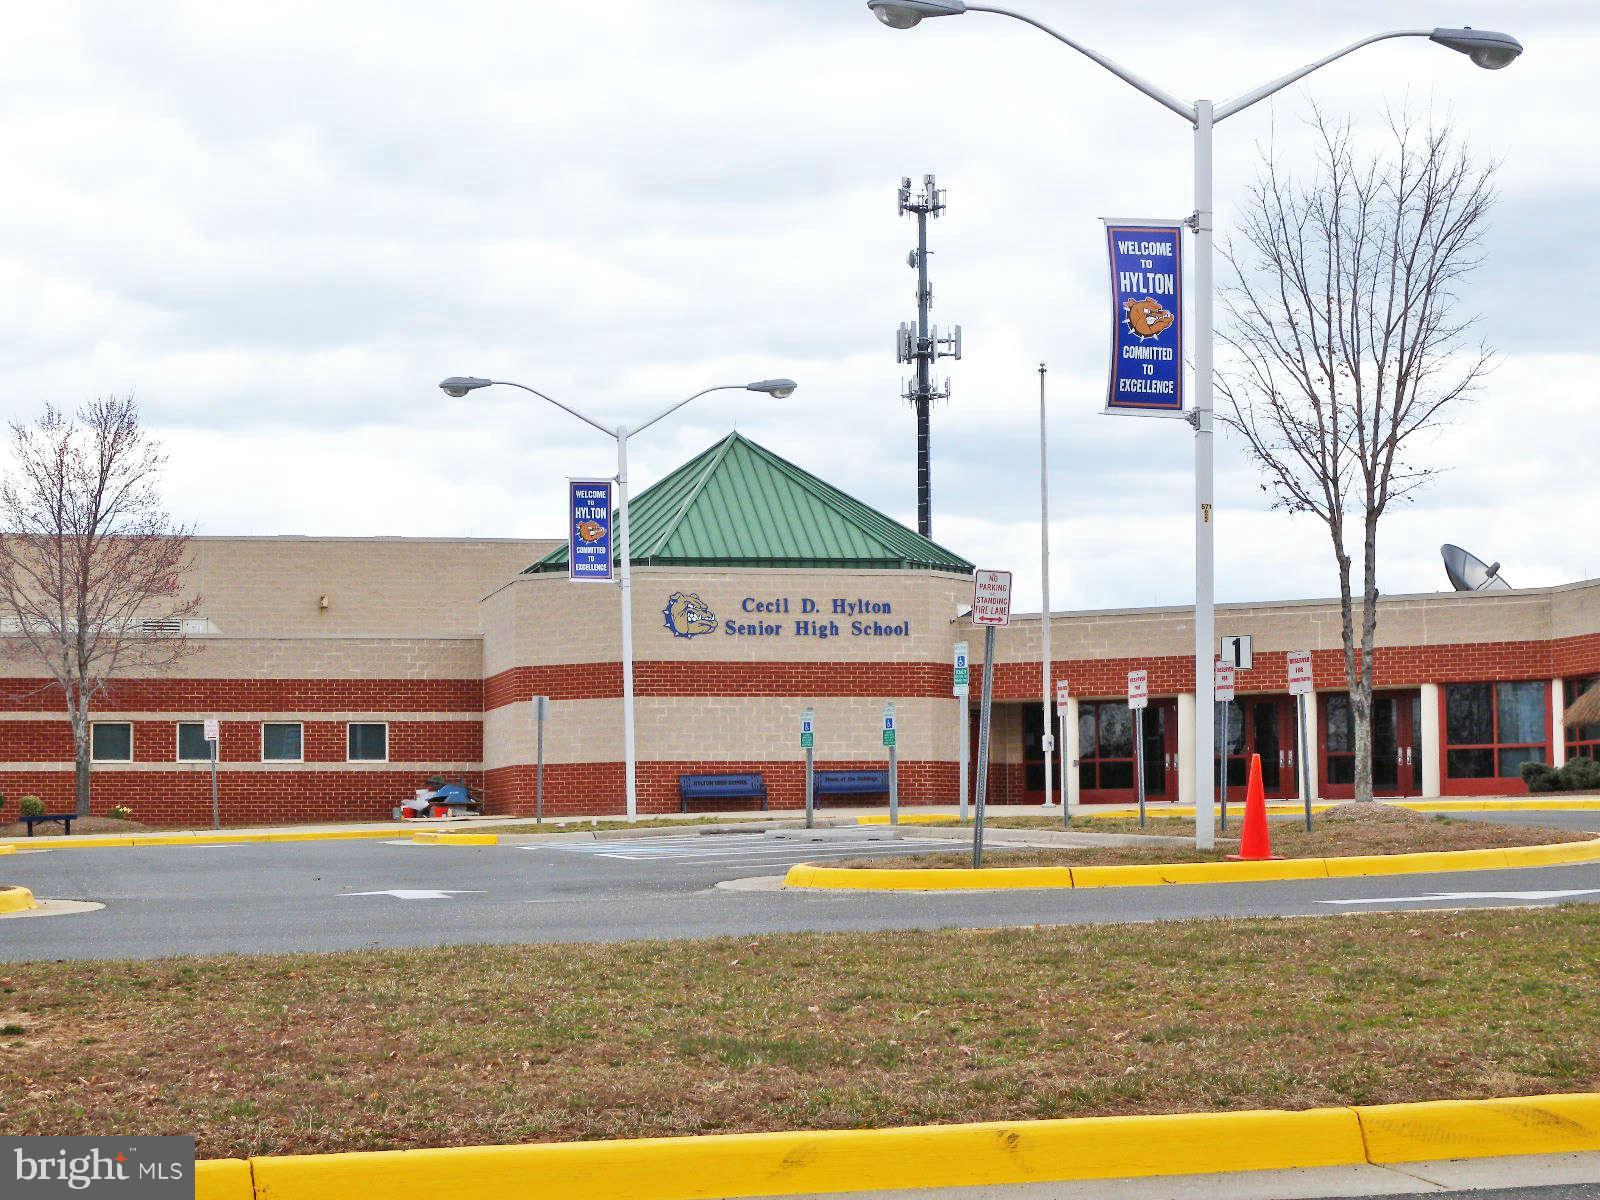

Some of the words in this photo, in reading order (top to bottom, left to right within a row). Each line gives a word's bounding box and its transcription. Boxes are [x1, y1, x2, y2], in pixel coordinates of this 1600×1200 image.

[1118, 241, 1172, 256] WELCOME
[1140, 259, 1153, 268] TO
[1120, 272, 1174, 295] HYLTON
[1123, 345, 1173, 361] COMMITTED
[1142, 363, 1154, 376] TO
[1119, 378, 1174, 394] EXCELLENCE
[575, 490, 606, 499] WELCOME
[575, 507, 607, 519] HYLTON
[576, 546, 606, 554] COMMITTED
[575, 563, 607, 571] EXCELLENCE
[979, 583, 1007, 592] PARKING
[741, 597, 790, 614] Cecil
[801, 598, 820, 614] D.
[832, 598, 892, 616] Hylton
[976, 596, 1008, 605] STANDING
[975, 605, 989, 615] FIRE
[990, 606, 1007, 616] LANE
[725, 619, 782, 636] Senior
[794, 620, 839, 639] High
[851, 620, 910, 637] School
[1232, 637, 1241, 667] 1
